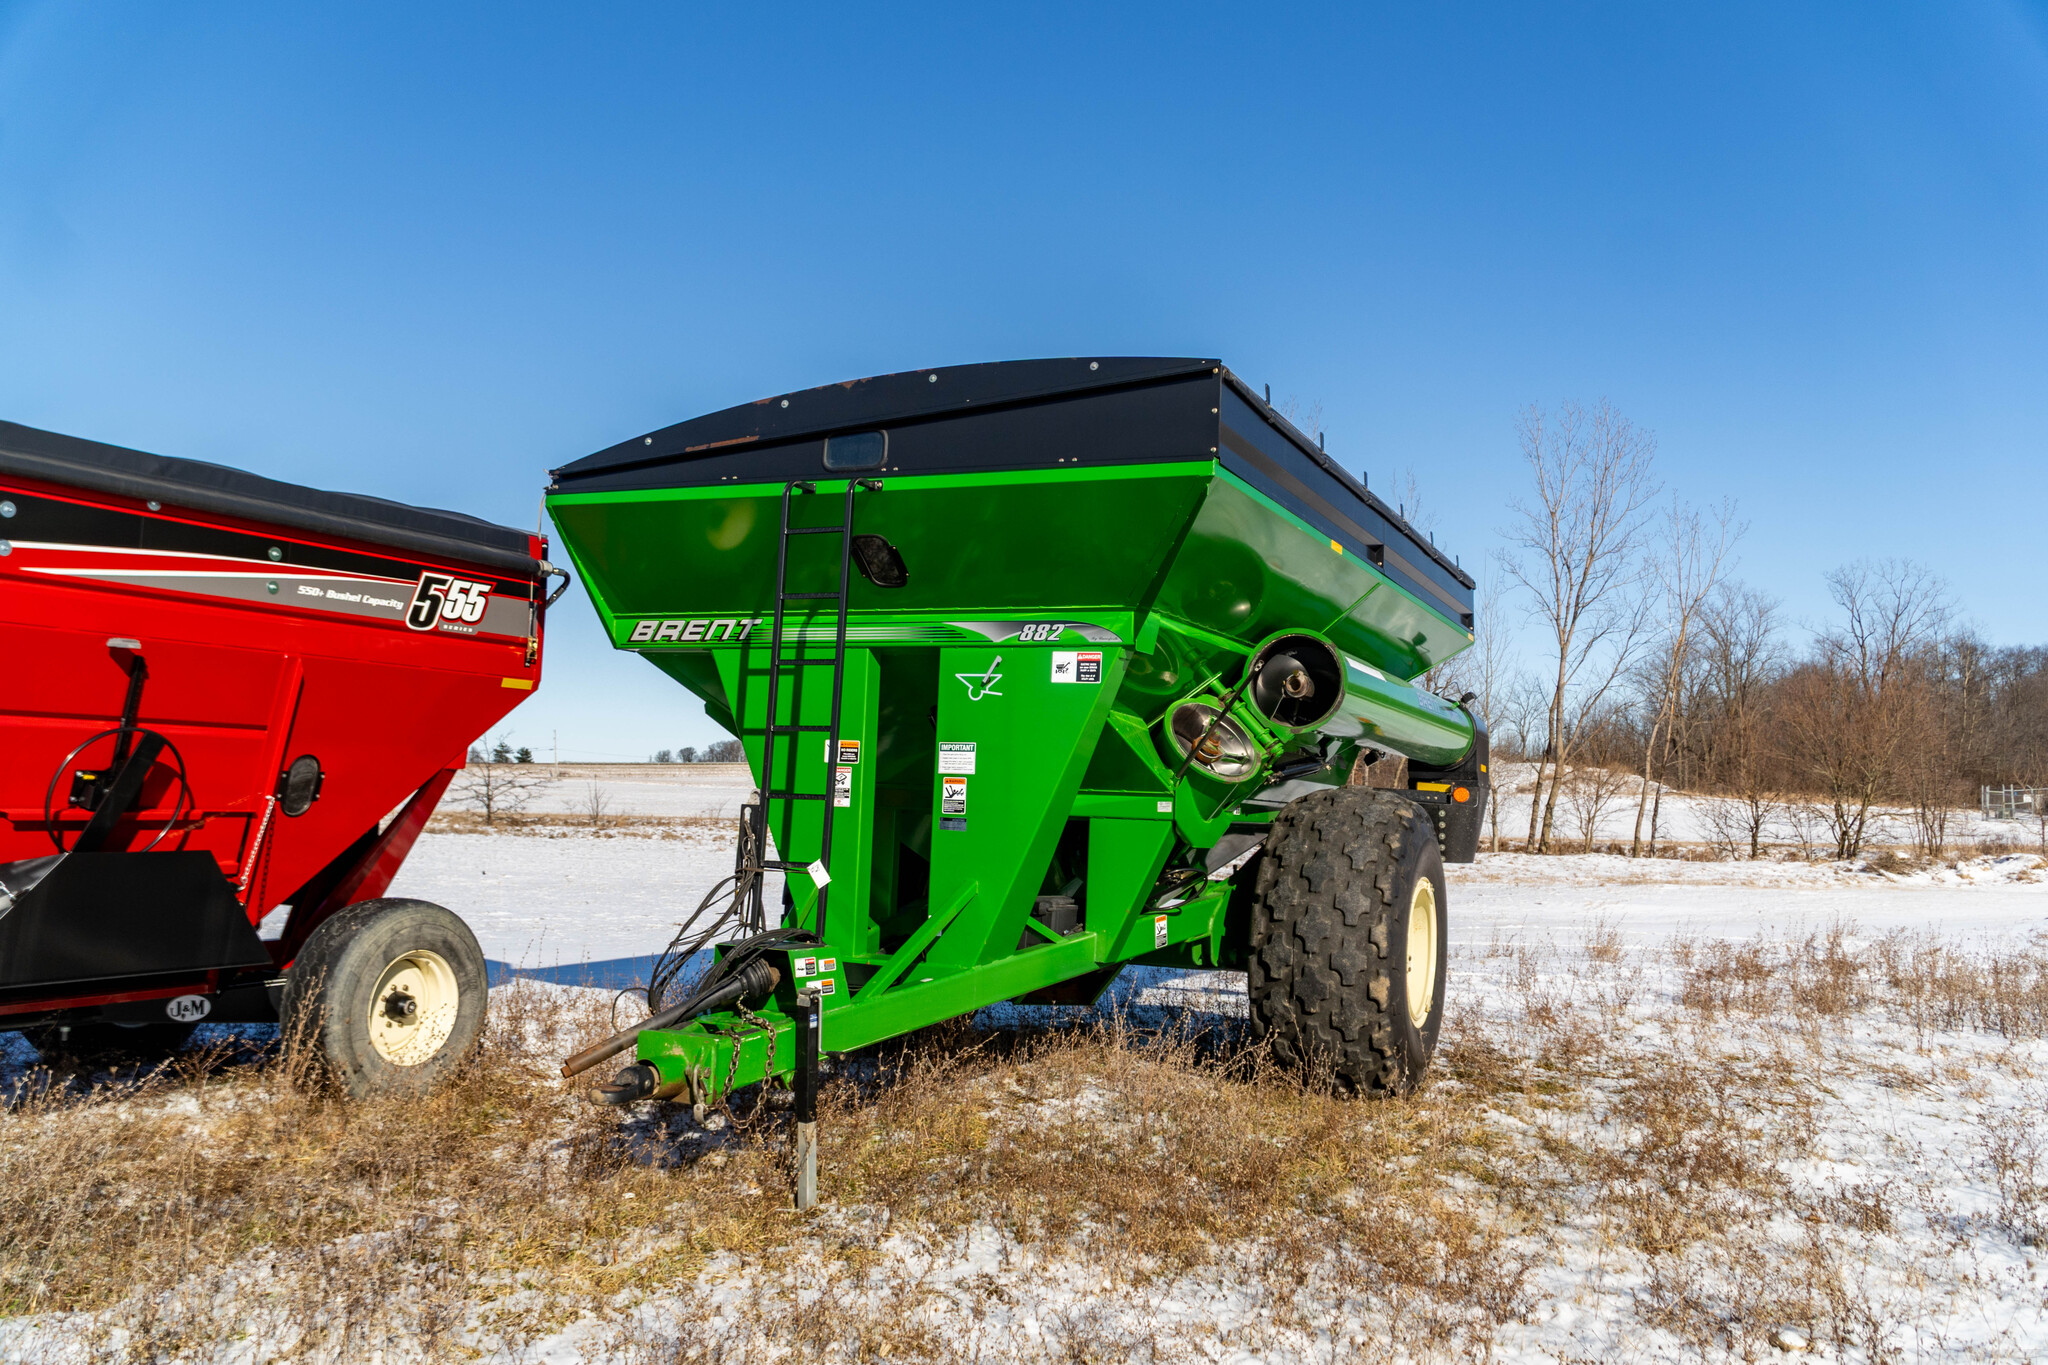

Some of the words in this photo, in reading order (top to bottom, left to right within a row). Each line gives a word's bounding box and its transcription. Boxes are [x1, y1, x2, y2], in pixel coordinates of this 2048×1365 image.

[297, 585, 324, 597] 550+
[326, 589, 362, 603] Bushel
[362, 594, 404, 610] Capacity
[405, 571, 492, 631] 555
[443, 624, 473, 632] SERIES
[629, 618, 763, 641] BRENT
[1019, 624, 1065, 642] 882
[941, 743, 974, 751] IMPORTANT
[170, 999, 206, 1017] J&M
